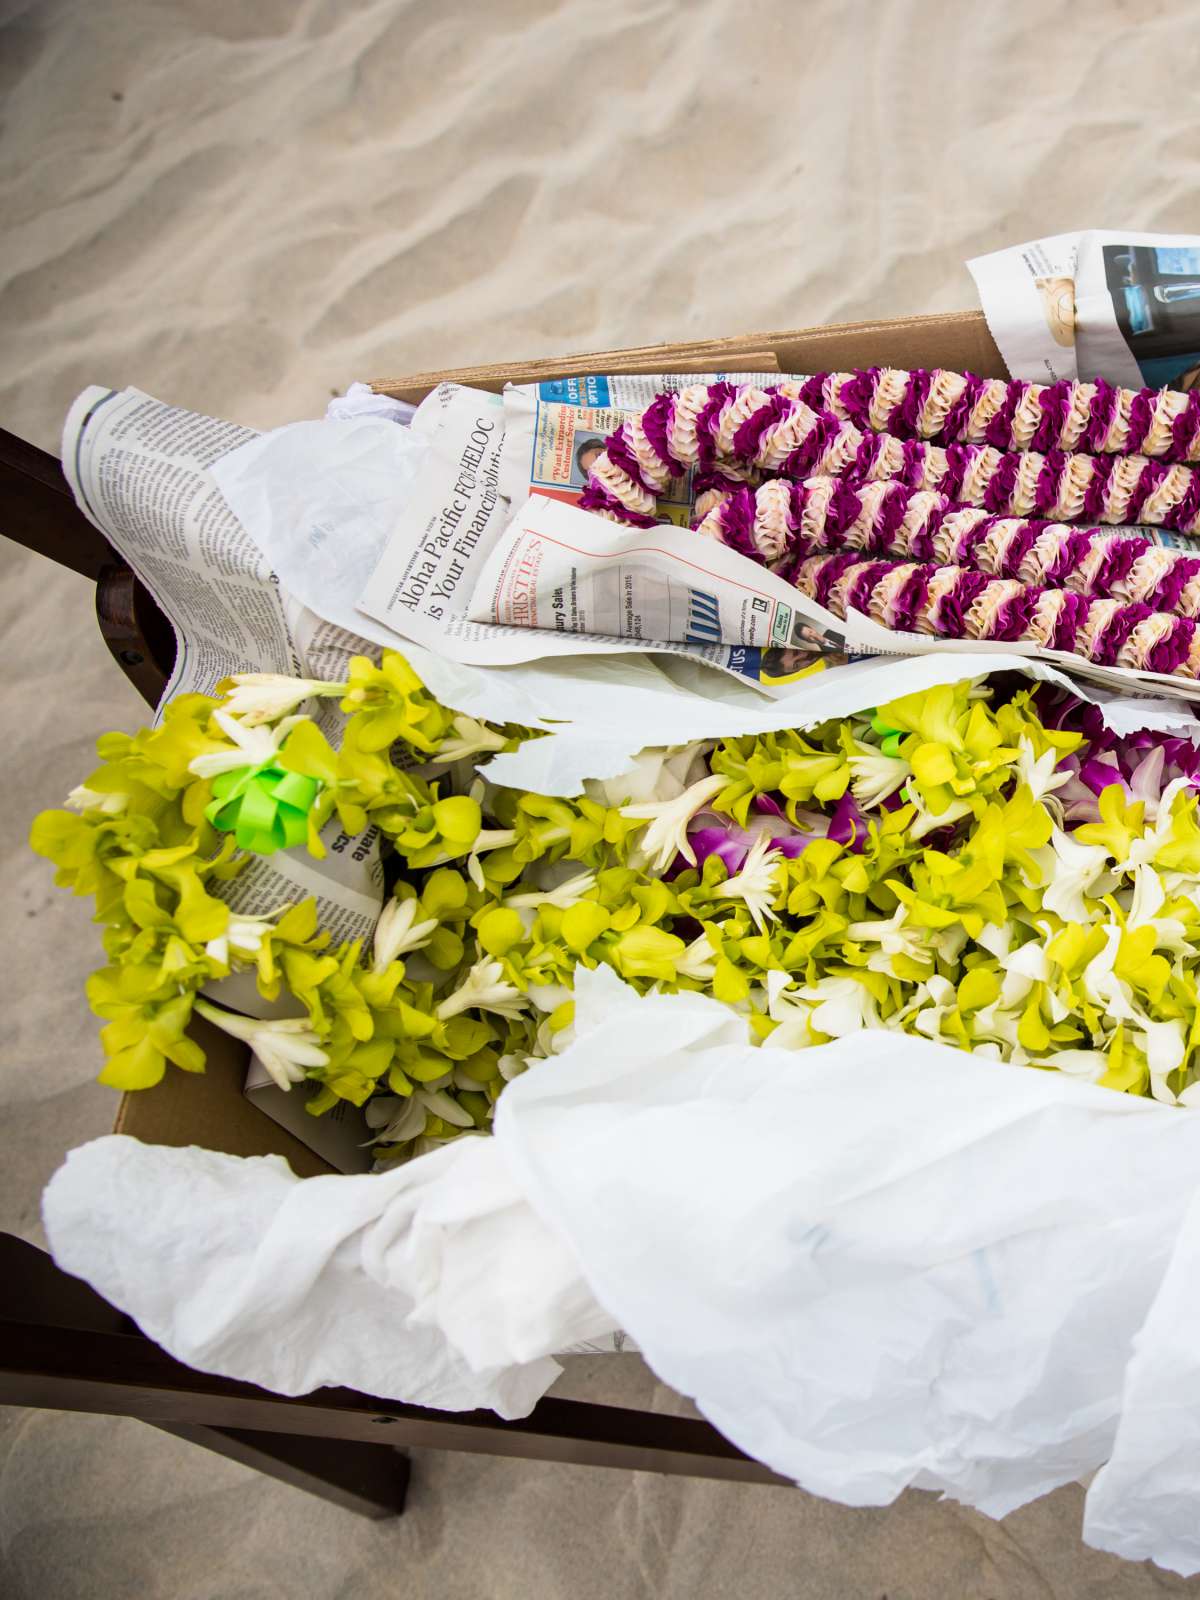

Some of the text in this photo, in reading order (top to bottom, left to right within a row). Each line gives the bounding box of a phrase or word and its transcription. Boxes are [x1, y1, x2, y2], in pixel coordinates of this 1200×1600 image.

[399, 560, 437, 613] Aloha
[425, 499, 467, 560] Pacific
[460, 417, 495, 475] HELOC
[432, 559, 465, 600] Your
[512, 539, 544, 626] HRISTIE'S
[423, 604, 443, 620] is
[733, 648, 746, 665] US
